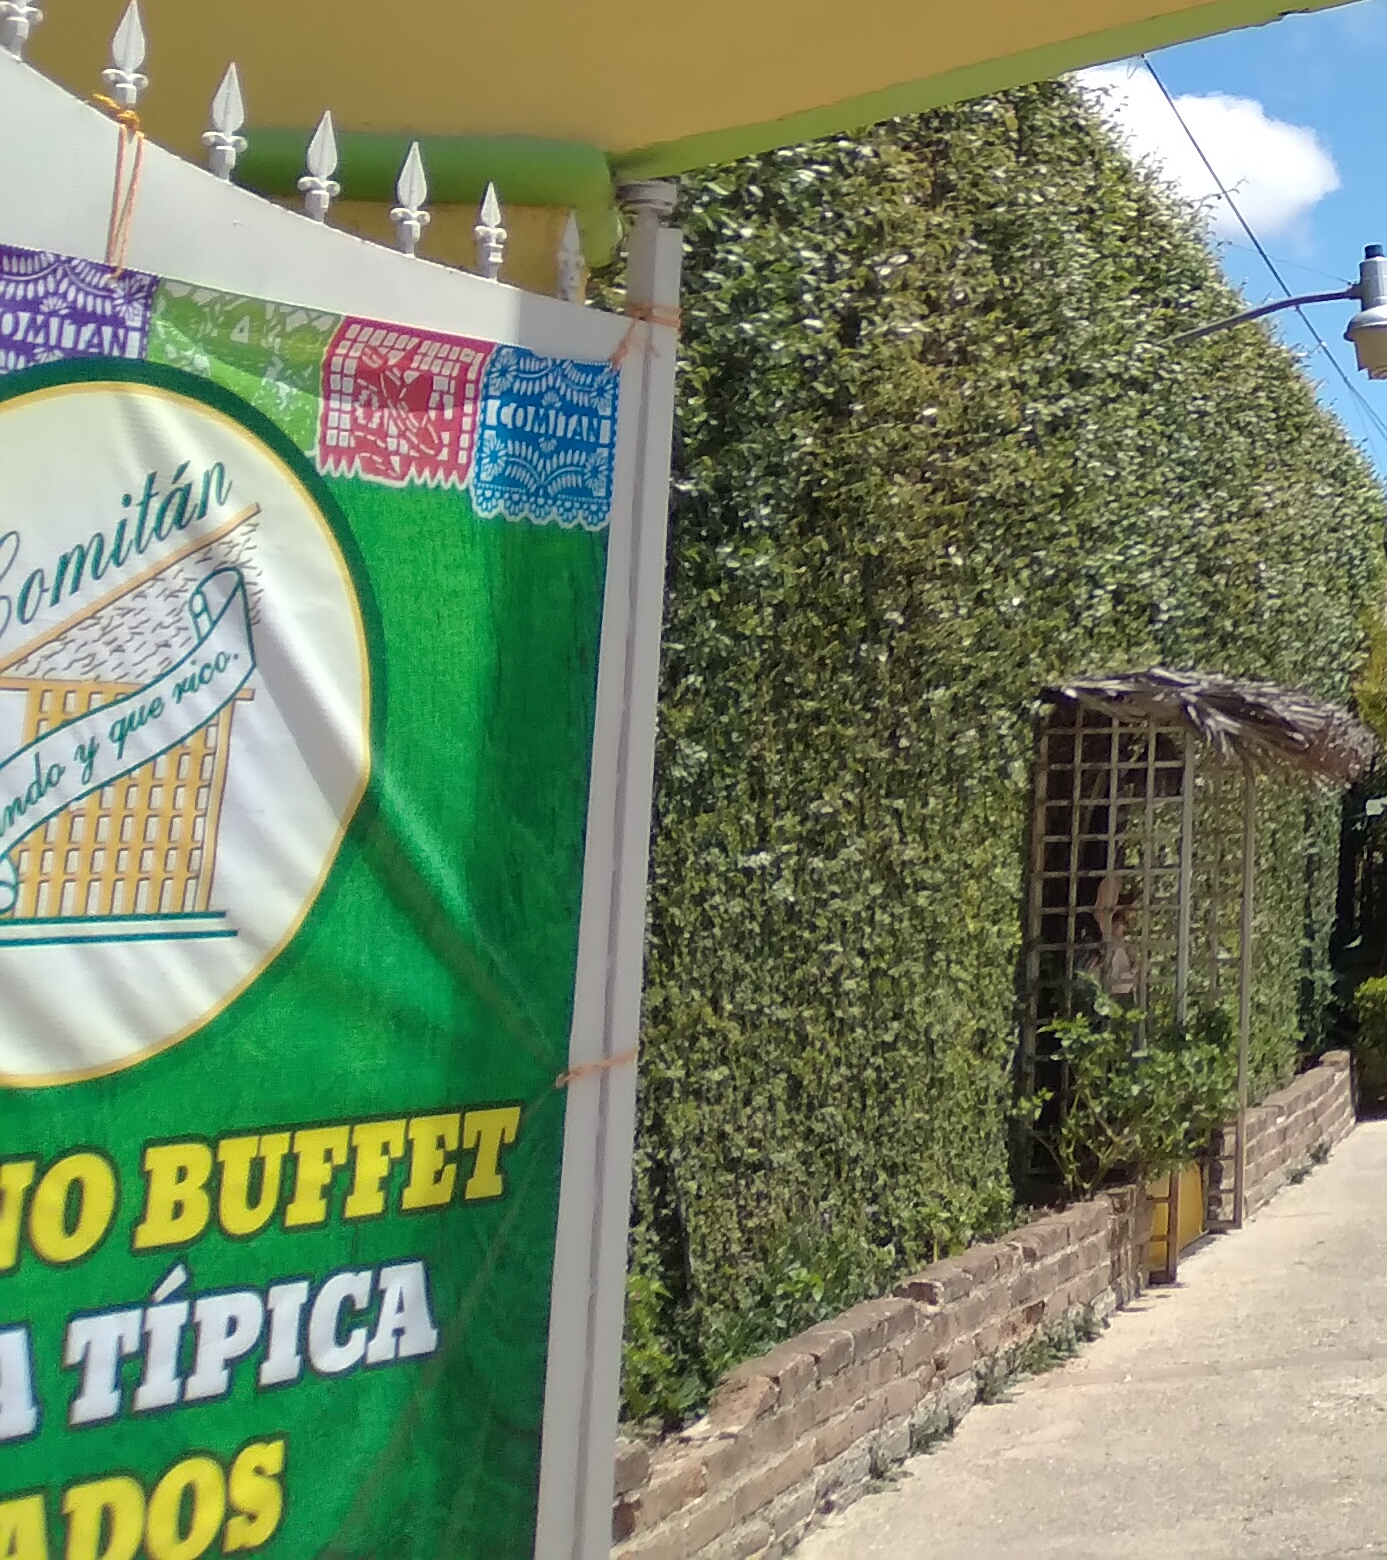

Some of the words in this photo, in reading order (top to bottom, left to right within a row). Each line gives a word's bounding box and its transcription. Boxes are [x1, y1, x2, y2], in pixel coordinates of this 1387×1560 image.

[0, 752, 65, 837] ndo
[74, 736, 99, 784] y
[108, 697, 164, 760] que
[133, 1106, 521, 1250] BUFFET
[65, 1262, 438, 1426] TÍPICA
